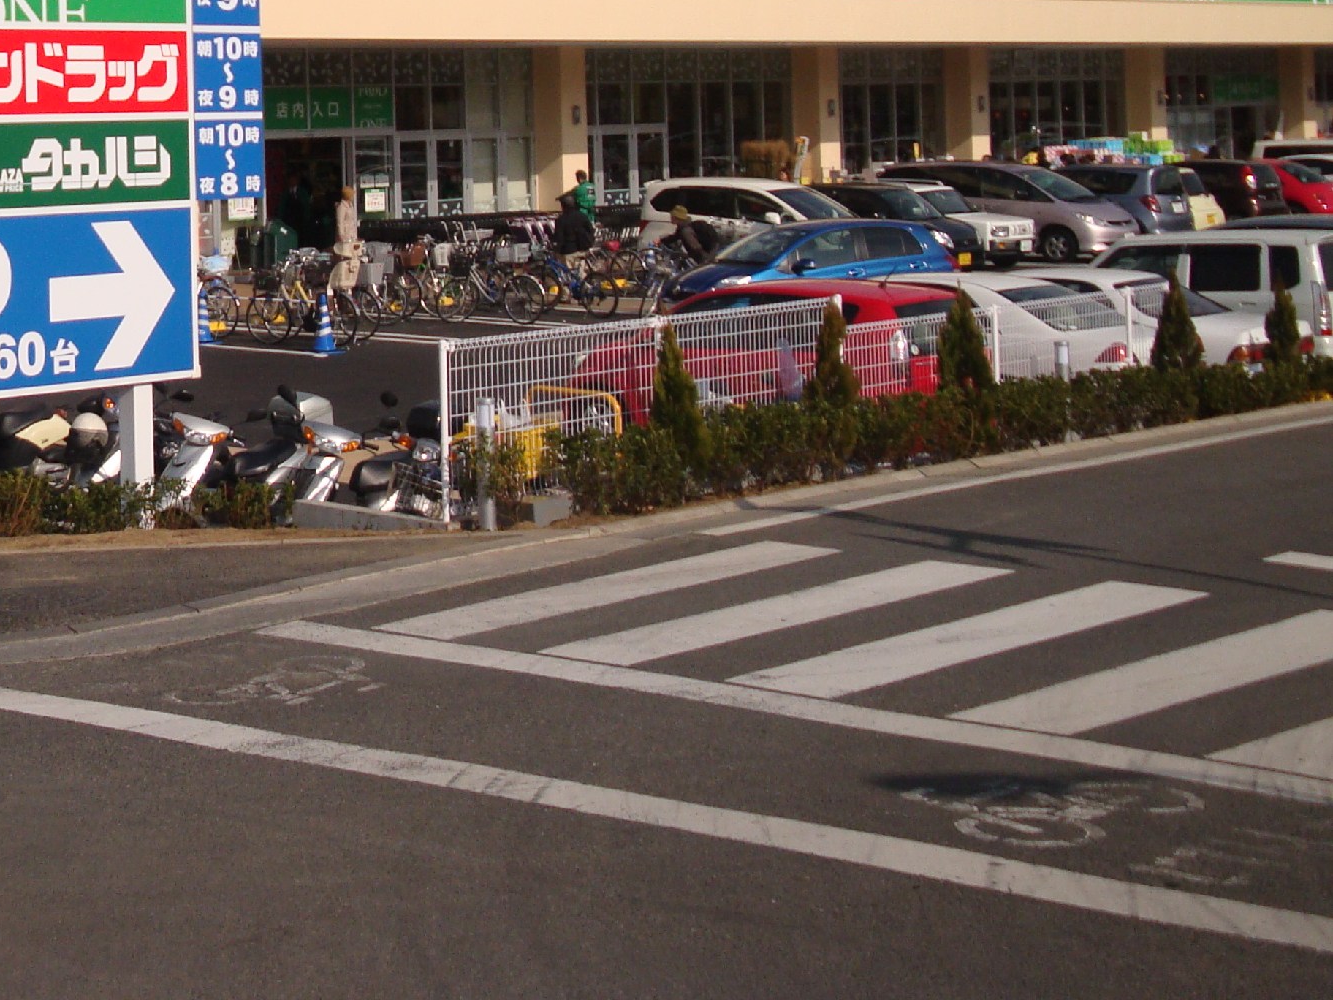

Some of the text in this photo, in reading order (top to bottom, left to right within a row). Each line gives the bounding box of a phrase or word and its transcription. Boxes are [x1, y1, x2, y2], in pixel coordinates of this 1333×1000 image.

[196, 36, 258, 60] 朝10時
[197, 85, 260, 109] 夜9時
[275, 101, 340, 118] 店内入口
[198, 123, 260, 147] 朝10時
[21, 135, 171, 192] タカハシ
[199, 172, 261, 196] 夜8時
